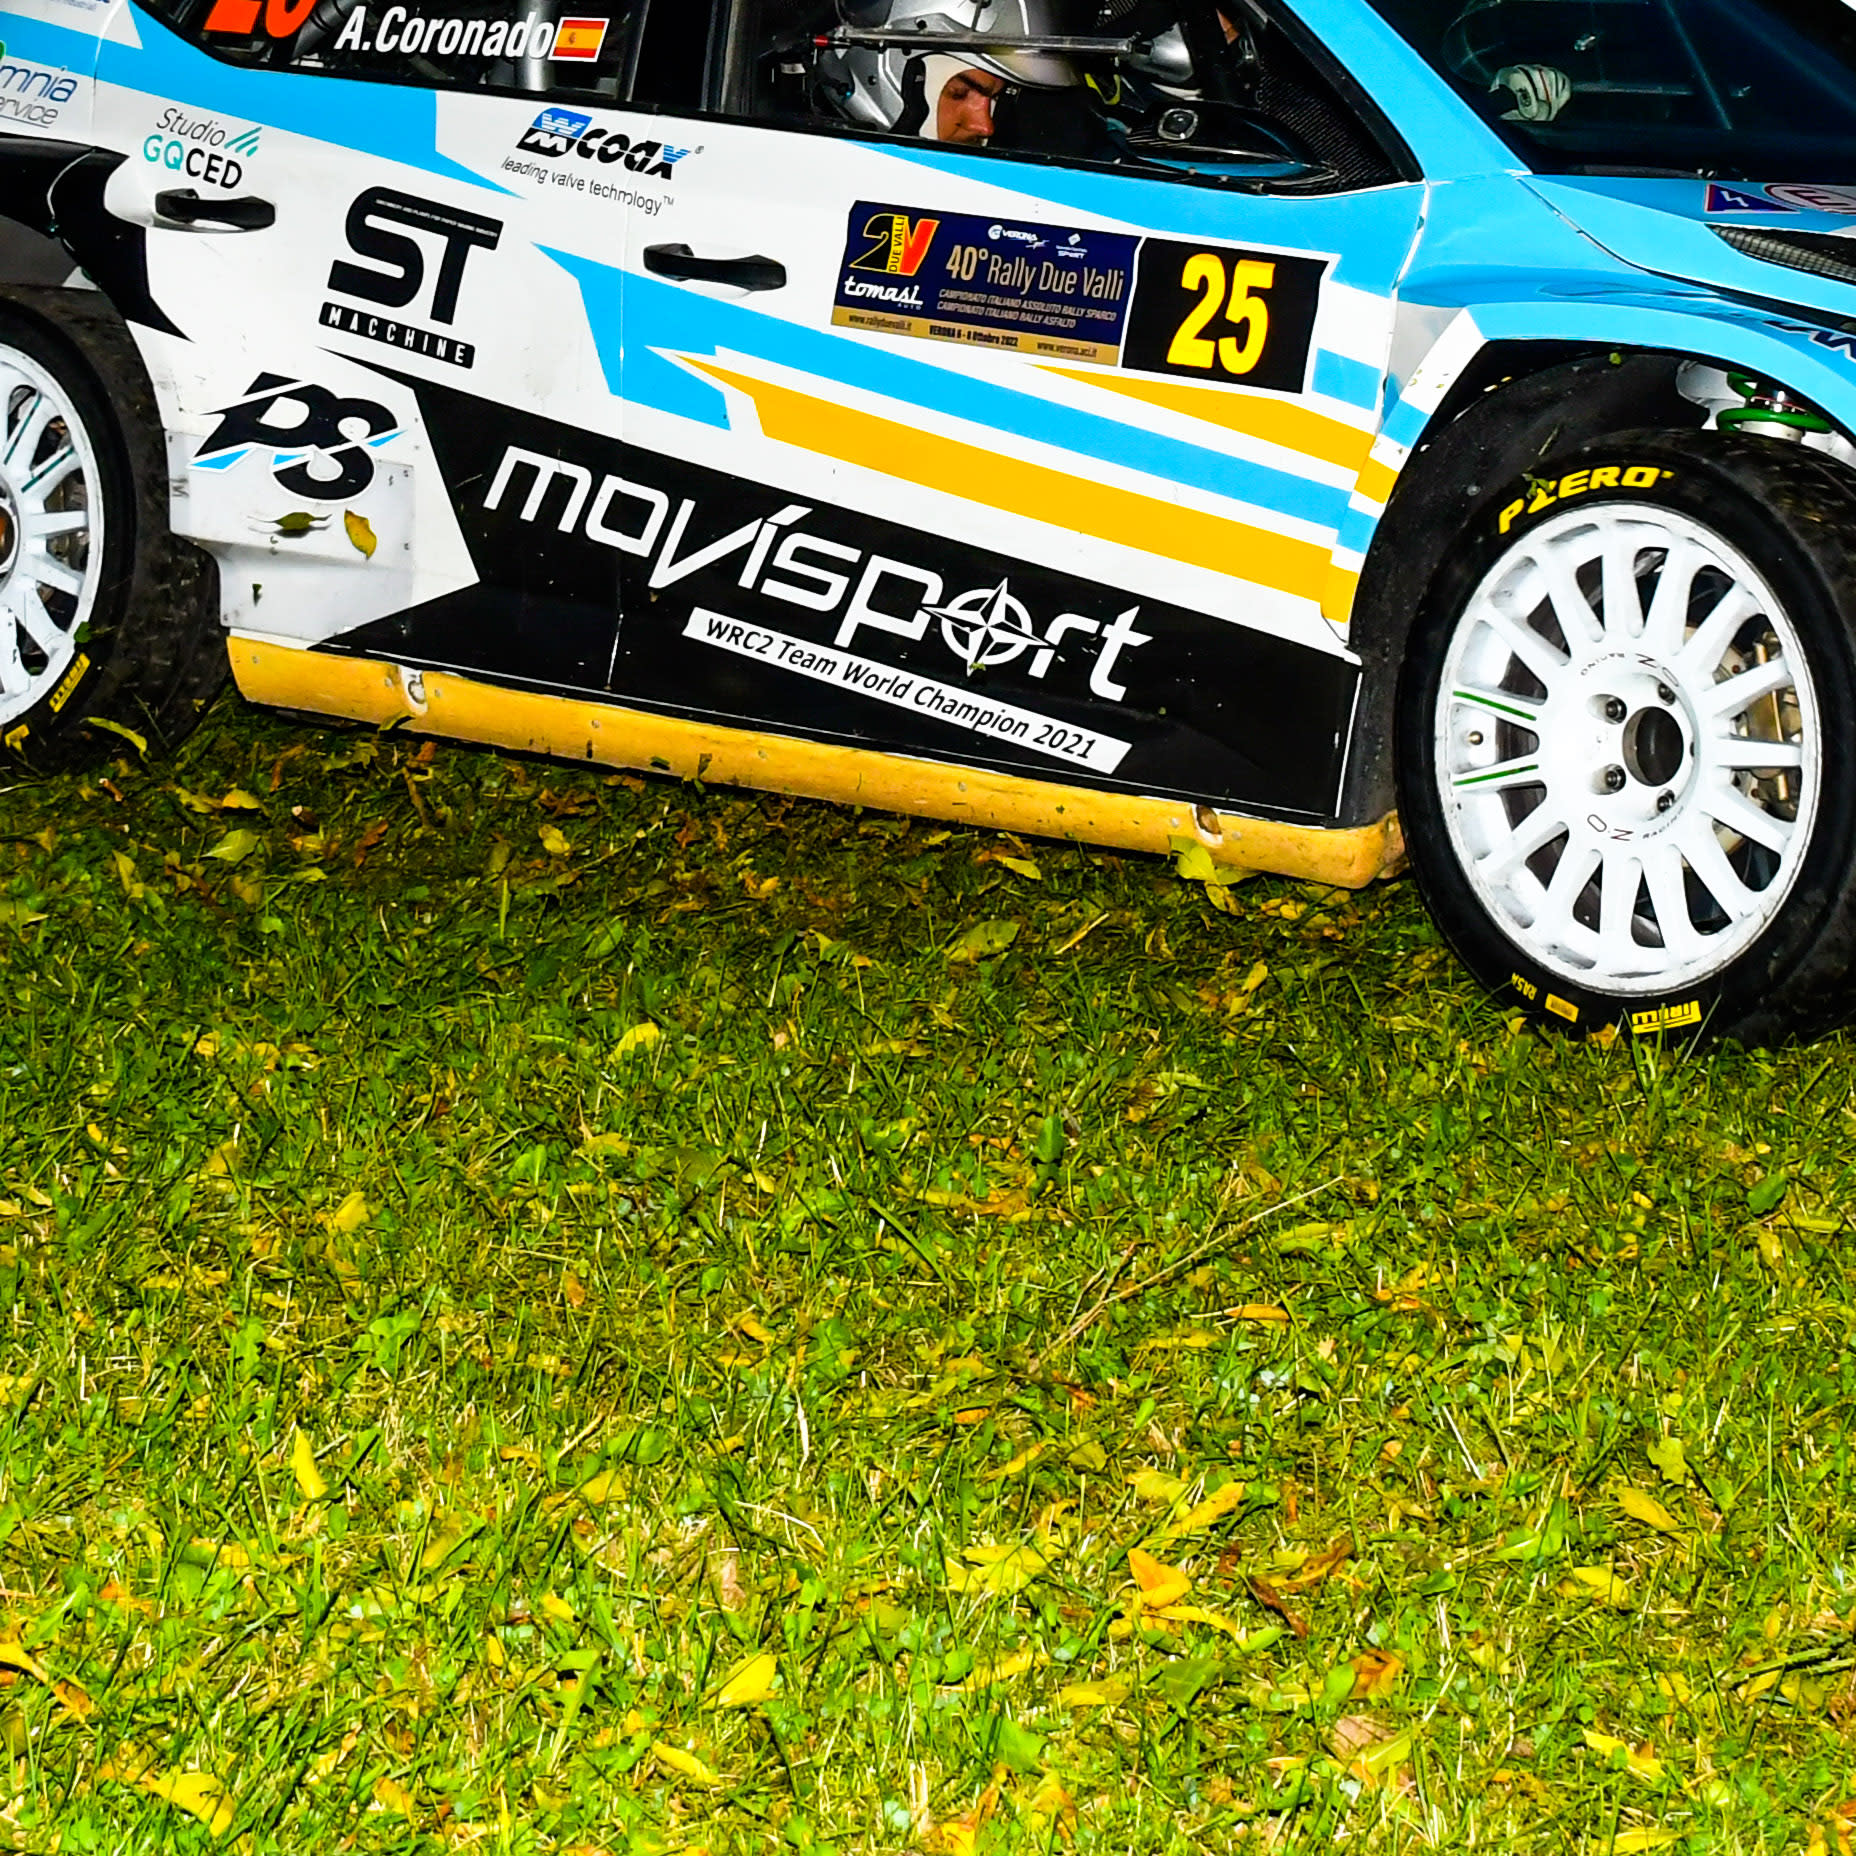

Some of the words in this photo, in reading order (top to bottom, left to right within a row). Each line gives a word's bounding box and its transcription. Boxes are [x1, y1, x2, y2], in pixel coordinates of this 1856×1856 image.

[334, 5, 555, 58] A.Coronado
[157, 108, 227, 147] Studio
[144, 134, 242, 190] GQCED
[501, 156, 548, 184] leading
[551, 168, 586, 191] valve
[327, 186, 504, 326] ST
[946, 245, 989, 282] 40°
[987, 255, 1037, 295] Rally
[1038, 261, 1077, 294] Due
[1082, 267, 1125, 301] Valli
[844, 275, 924, 305] tomasi
[1166, 252, 1277, 376] 25
[328, 306, 467, 364] MACCHINE
[706, 617, 775, 655] WRC2
[777, 640, 838, 677] Team
[842, 659, 914, 700] World
[913, 685, 1031, 739] Champion
[1032, 723, 1098, 760] 2021
